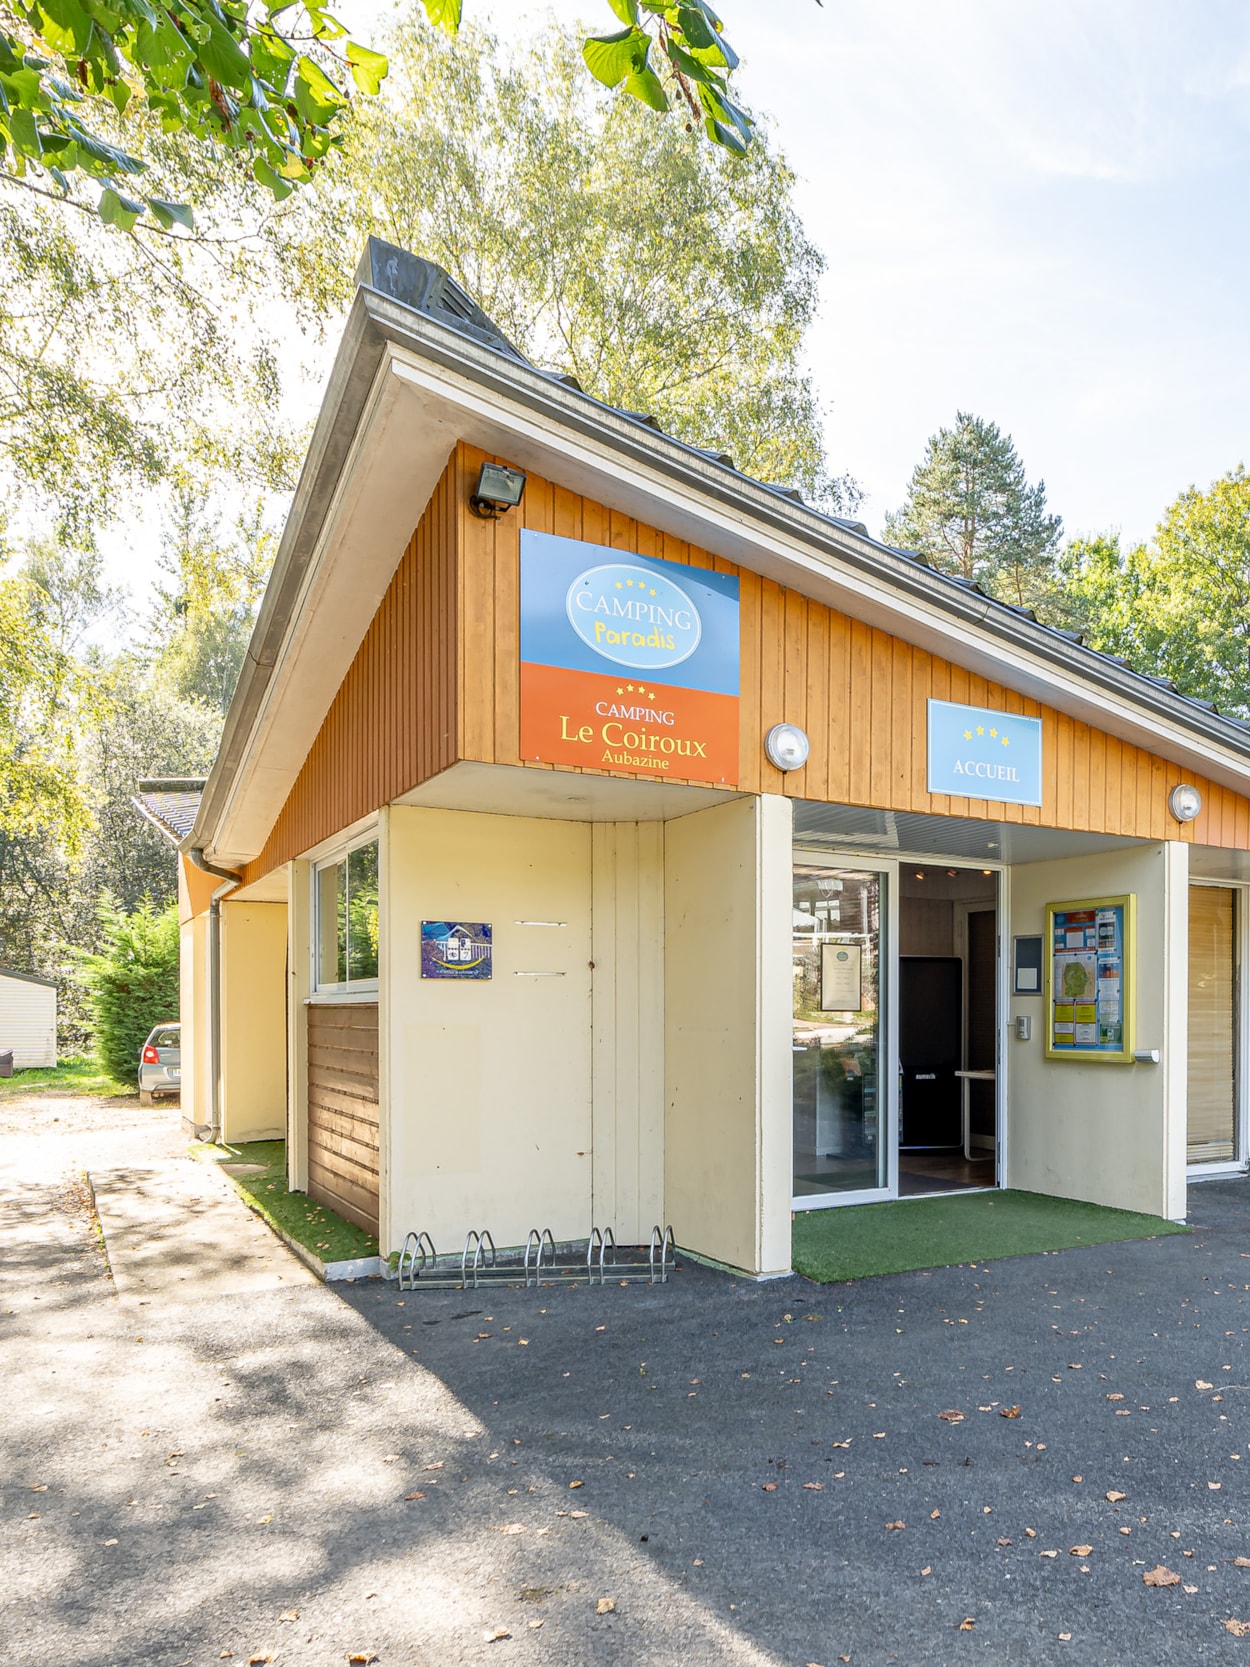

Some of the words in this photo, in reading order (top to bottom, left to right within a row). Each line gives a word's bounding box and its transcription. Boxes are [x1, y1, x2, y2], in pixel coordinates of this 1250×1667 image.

[576, 591, 691, 630] CAMPING
[594, 621, 675, 651] Paradis
[595, 701, 675, 726] CAMPING
[560, 715, 593, 743] Le
[601, 722, 707, 758] Coiroux
[601, 749, 670, 769] Aubazine
[953, 759, 1021, 782] ACCUEIL
